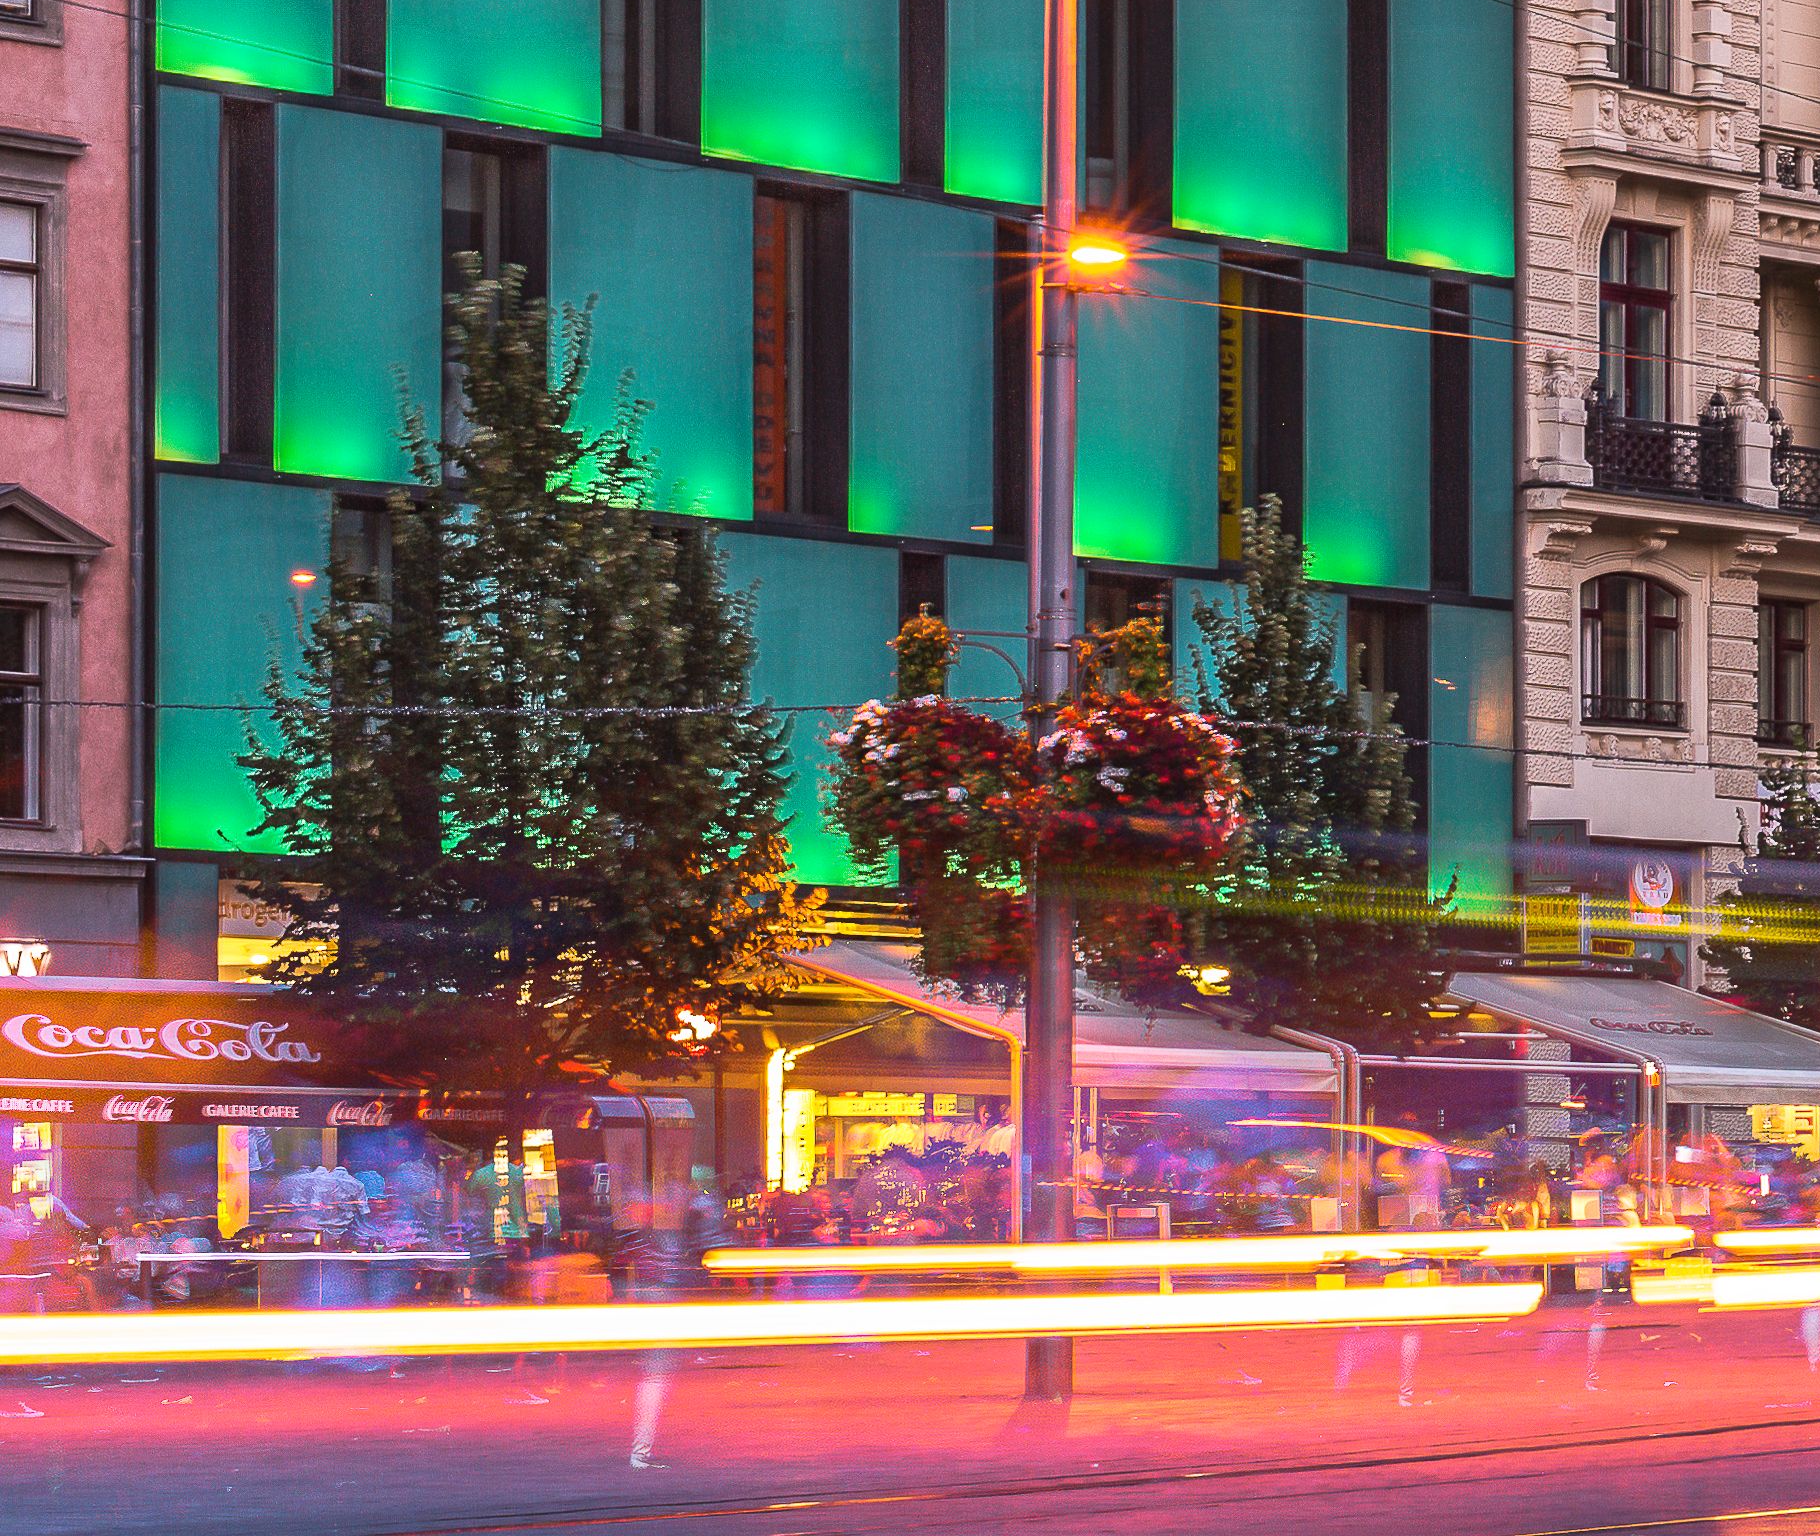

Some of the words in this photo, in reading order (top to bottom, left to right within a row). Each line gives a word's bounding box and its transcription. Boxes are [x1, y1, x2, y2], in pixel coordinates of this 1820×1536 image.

[2, 1014, 321, 1062] Coca-Cola
[202, 1104, 258, 1119] GALERIE
[258, 1105, 300, 1119] CAFFE
